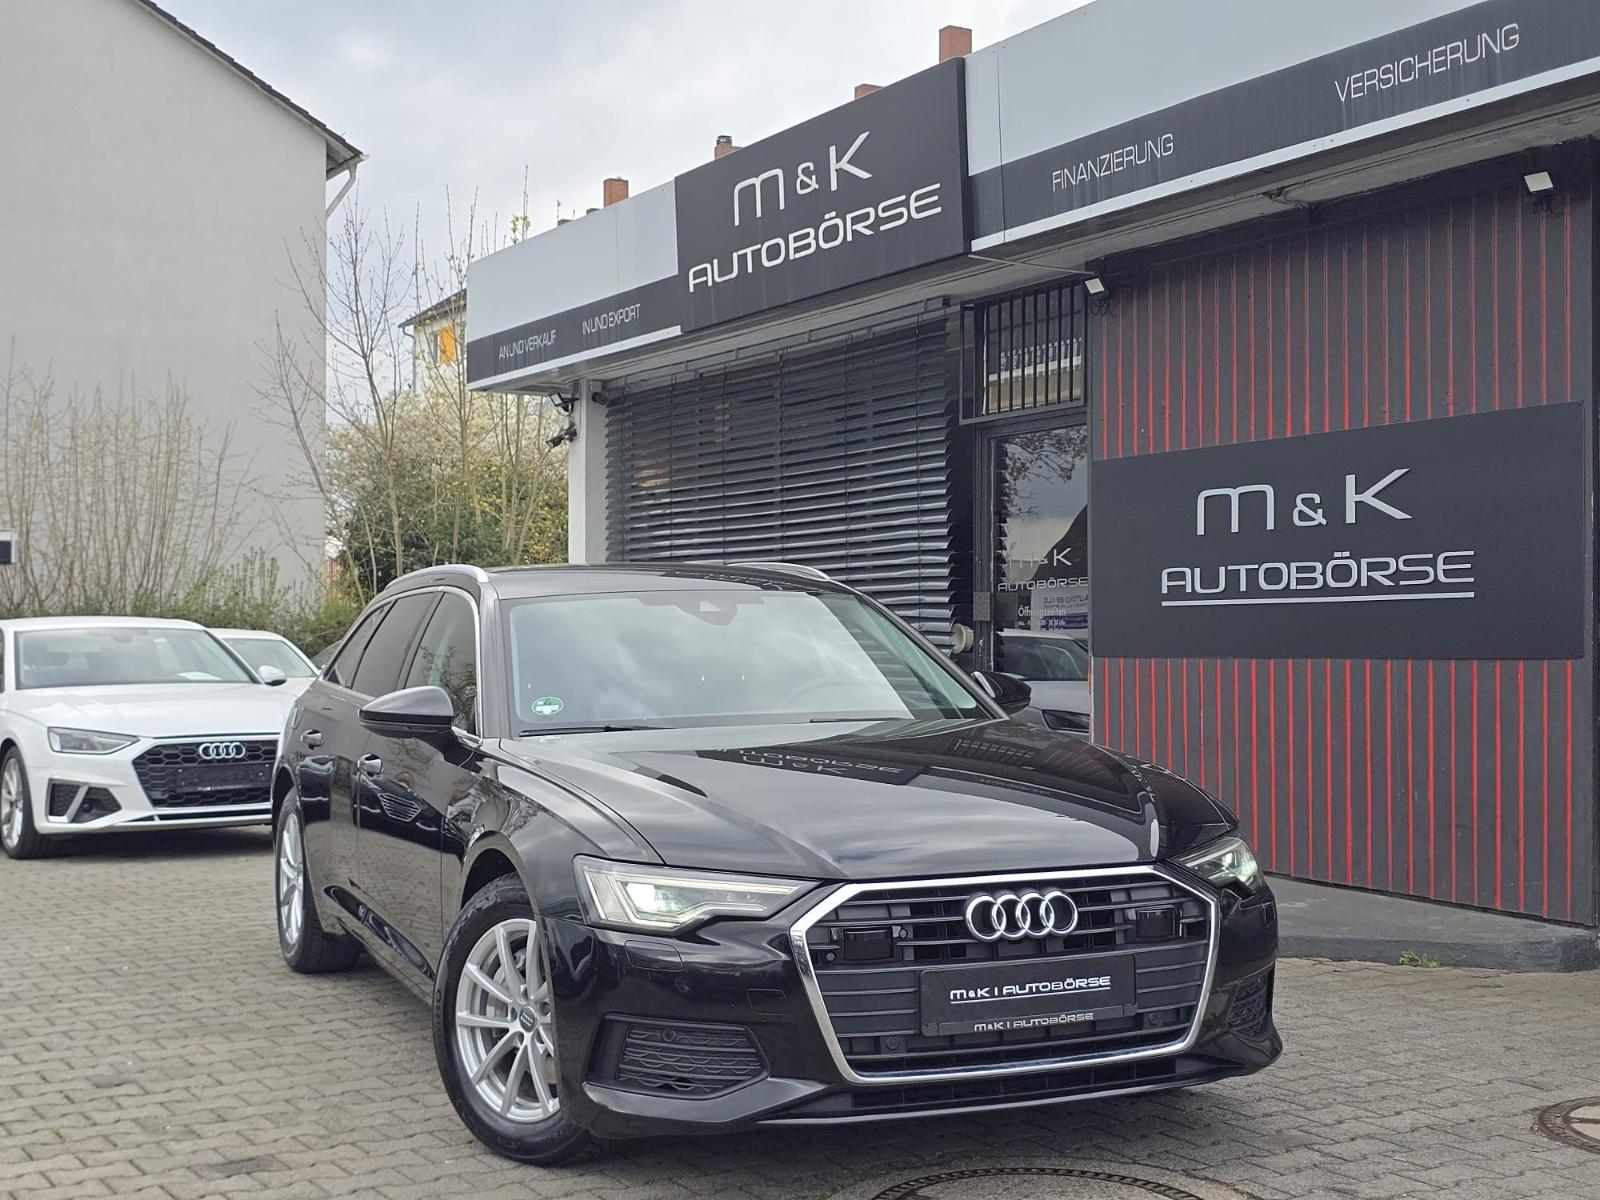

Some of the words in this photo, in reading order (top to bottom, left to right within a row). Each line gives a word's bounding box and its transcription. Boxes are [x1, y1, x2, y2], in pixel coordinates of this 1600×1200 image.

[1334, 23, 1520, 103] VERSICHERUNG
[796, 161, 819, 195] &
[829, 131, 873, 191] K
[1052, 133, 1174, 192] FINANZIERUNG
[688, 183, 942, 293] AUTOBÖRSE
[608, 303, 641, 327] EXPORT
[523, 329, 557, 353] VERKAUF
[1292, 493, 1327, 527] &
[1346, 468, 1413, 525] K
[1053, 547, 1073, 567] K
[1161, 550, 1475, 594] AUTOBÖRSE
[997, 577, 1089, 592] AUTOBÖRSE
[1003, 976, 1111, 995] AUTOBÖRSE
[1013, 1012, 1094, 1028] AUTOBÖRSE
